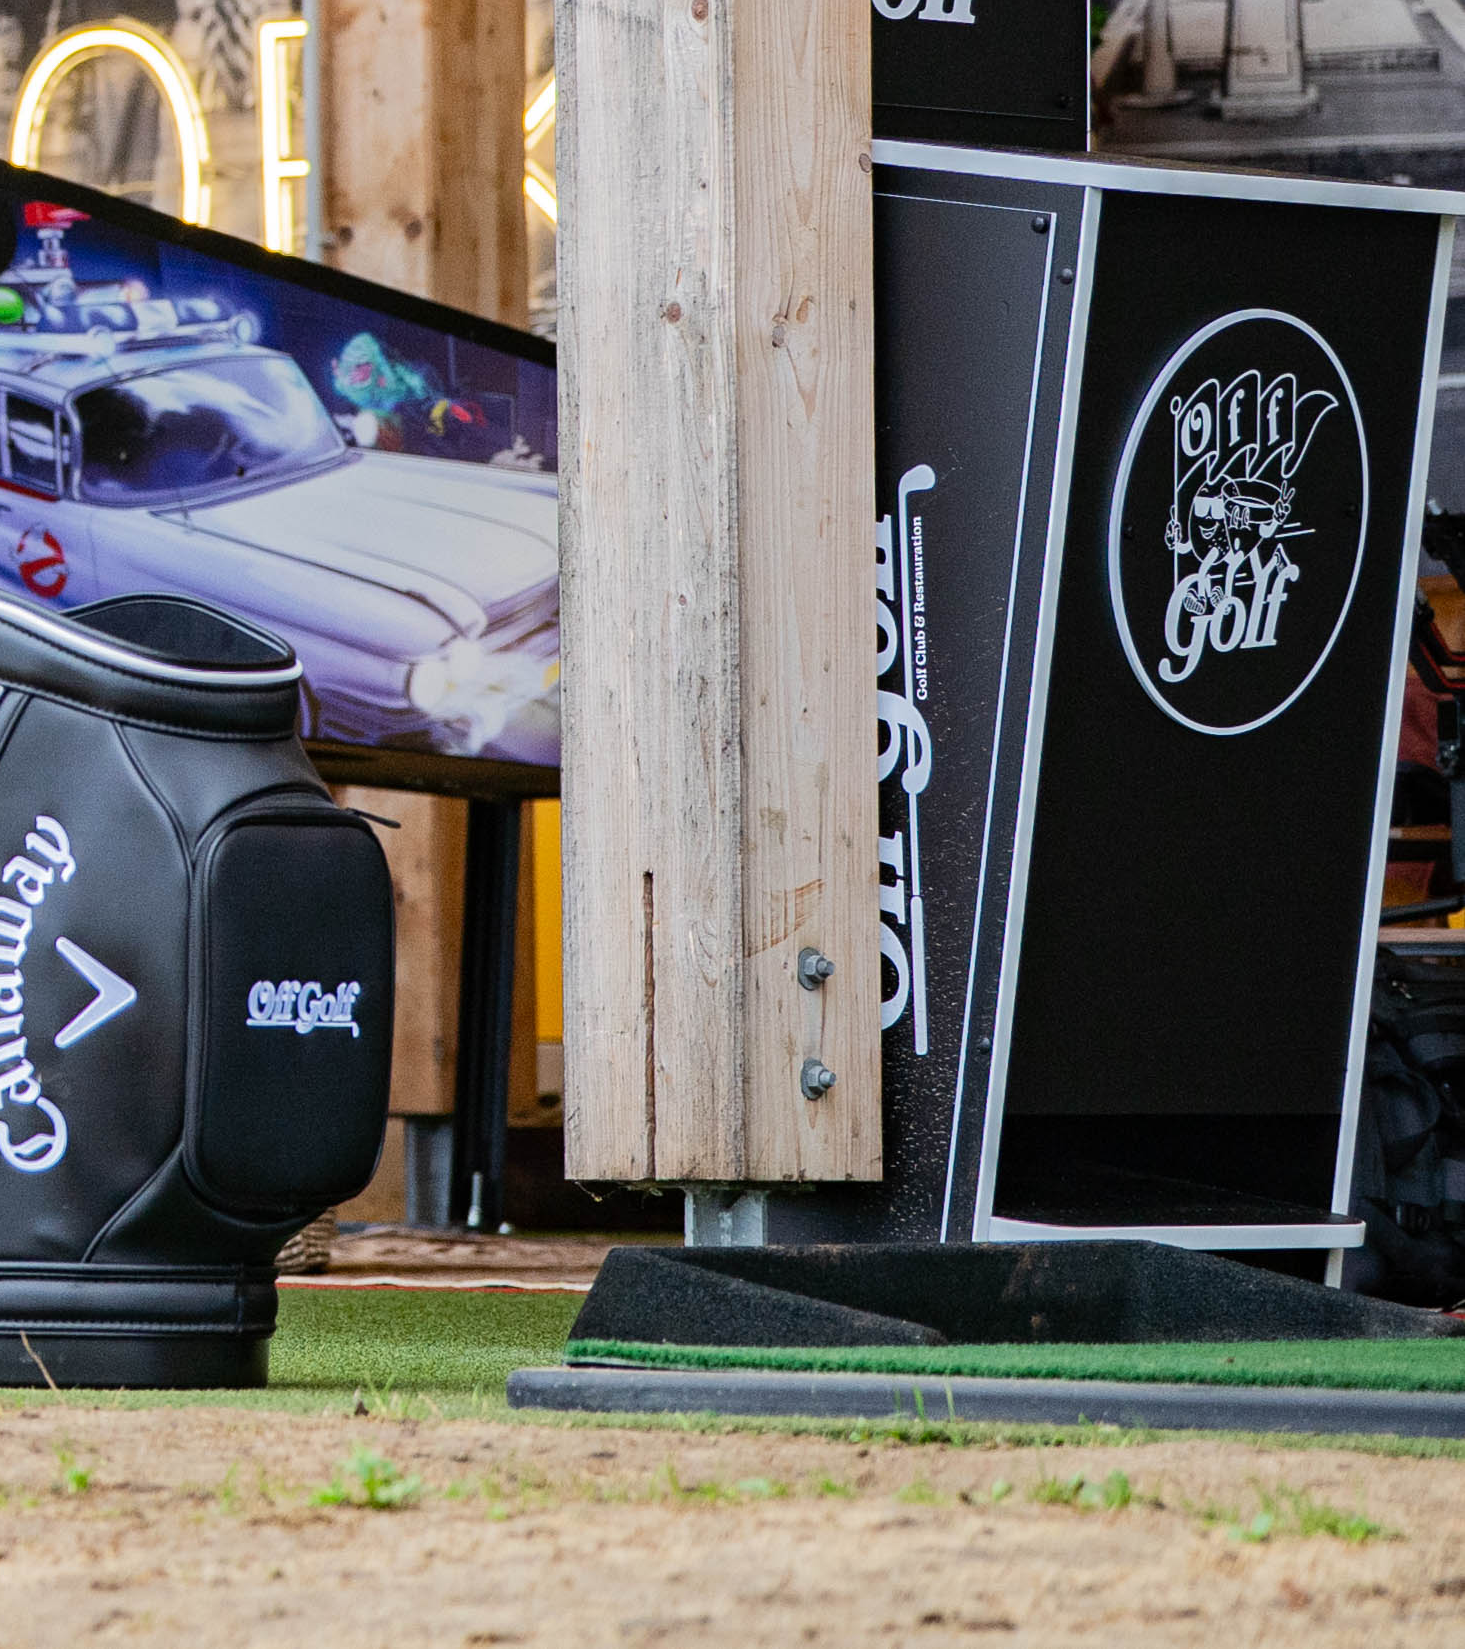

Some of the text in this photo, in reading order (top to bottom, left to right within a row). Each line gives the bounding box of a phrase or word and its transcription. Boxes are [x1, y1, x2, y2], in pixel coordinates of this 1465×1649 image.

[1181, 388, 1284, 457] Off
[911, 516, 925, 612] Restauration
[915, 630, 927, 666] Club
[917, 668, 928, 700] Golf
